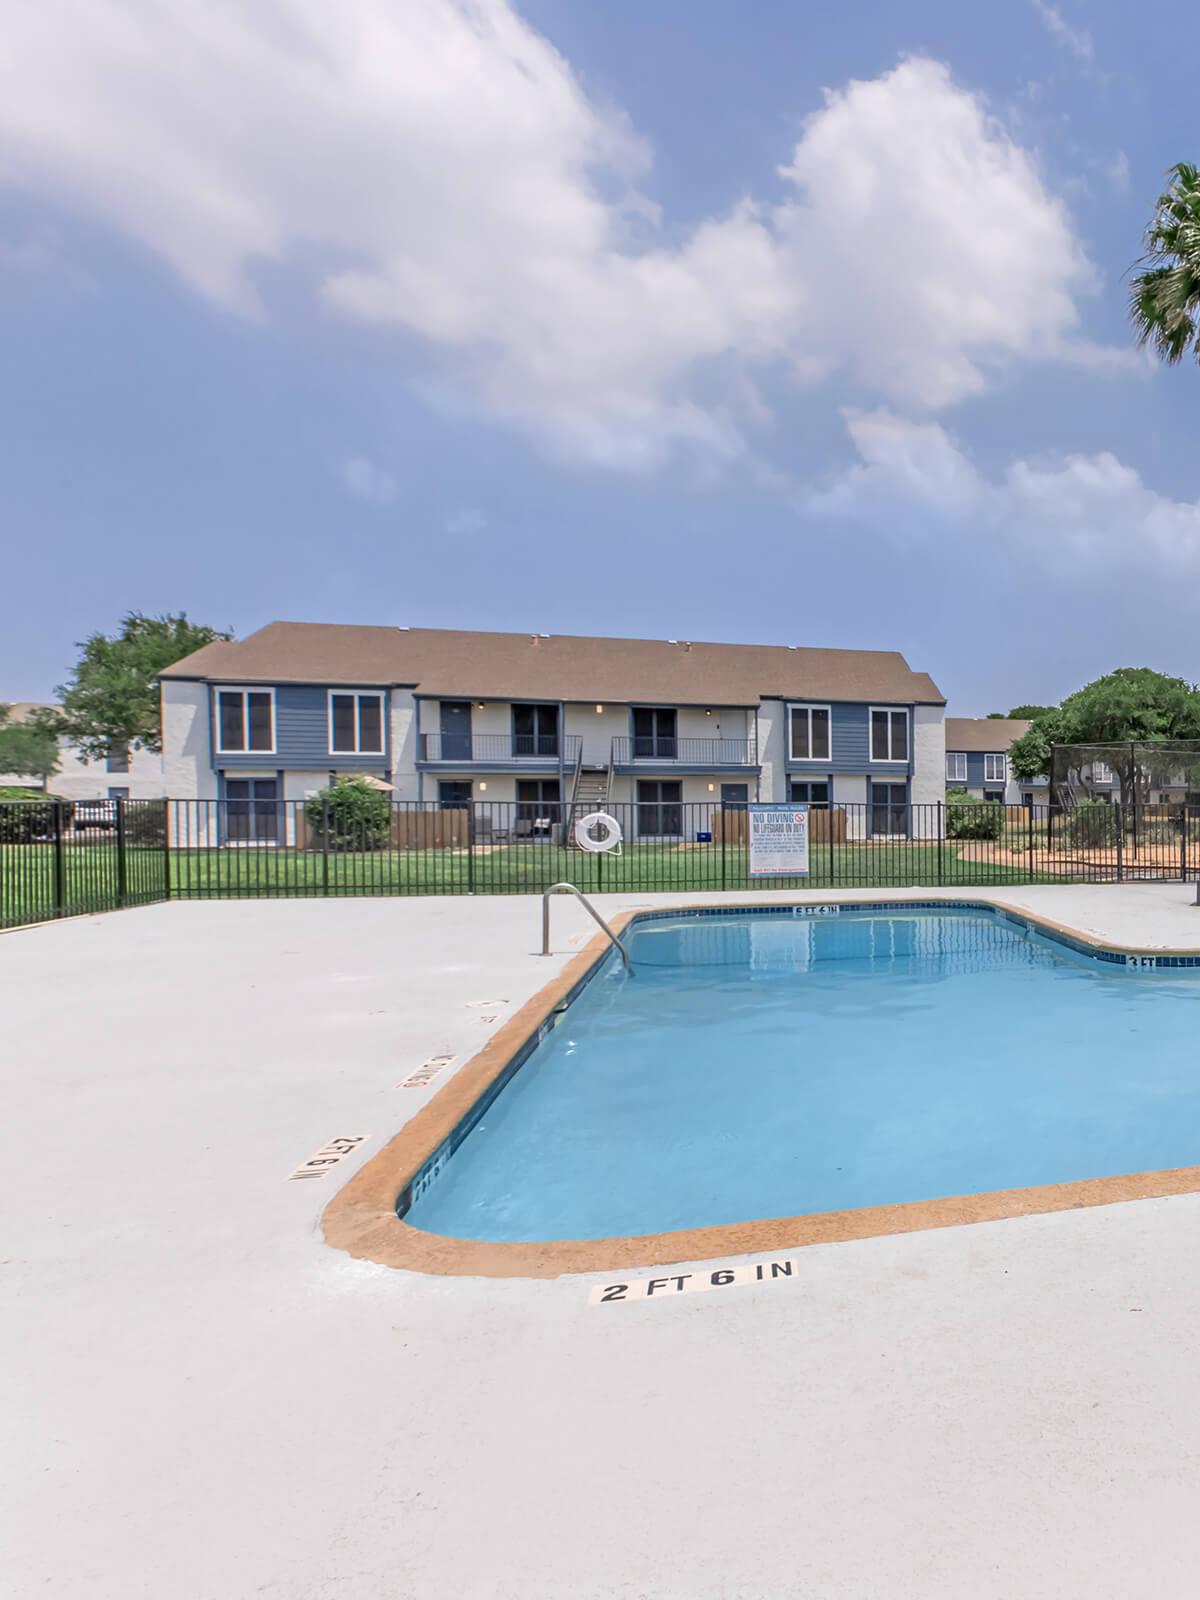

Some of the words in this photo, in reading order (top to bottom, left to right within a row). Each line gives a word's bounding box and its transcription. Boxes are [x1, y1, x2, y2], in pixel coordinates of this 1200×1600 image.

[753, 813, 765, 823] NO
[767, 813, 794, 823] DIVING
[1128, 956, 1138, 966] 3
[1141, 957, 1155, 967] FT
[318, 1145, 356, 1156] FT
[306, 1158, 340, 1166] 6
[288, 1168, 329, 1181] IN
[600, 1284, 629, 1302] 2
[647, 1274, 692, 1296] FT
[710, 1270, 735, 1286] 6
[756, 1261, 793, 1280] IN
